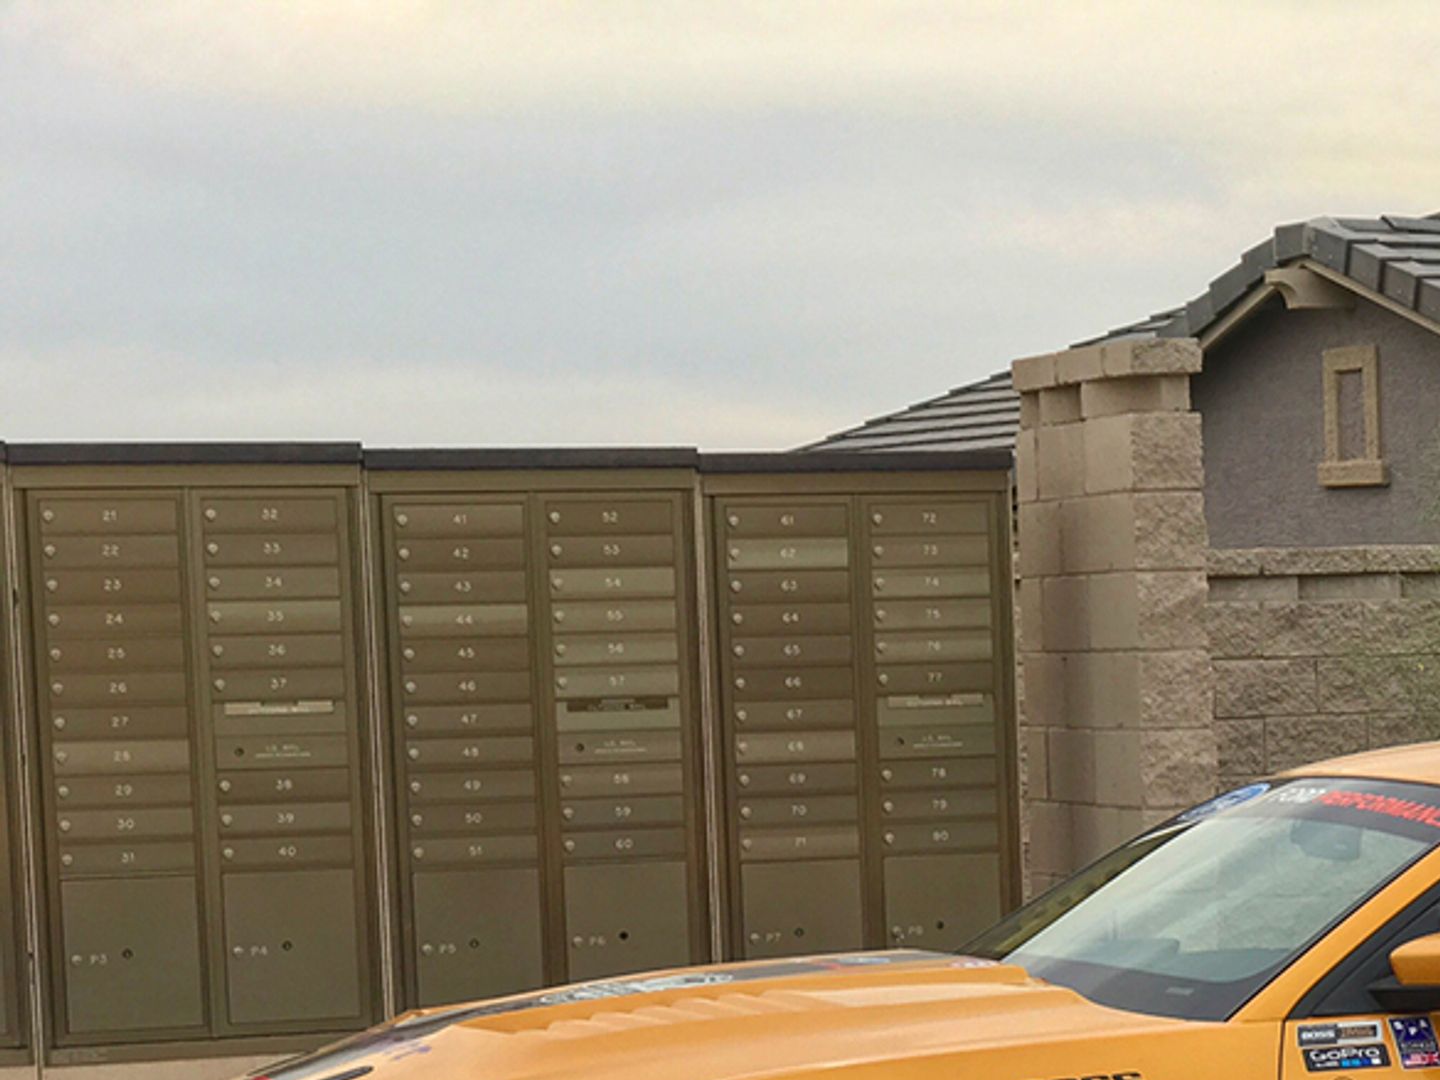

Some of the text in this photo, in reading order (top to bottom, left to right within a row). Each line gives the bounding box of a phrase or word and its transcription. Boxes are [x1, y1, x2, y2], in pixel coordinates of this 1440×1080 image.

[103, 510, 116, 521] 21
[262, 509, 277, 519] 32
[454, 514, 466, 524] 41
[603, 512, 617, 522] 52
[923, 513, 936, 523] 72
[781, 516, 793, 526] 61
[103, 545, 119, 556] 22
[264, 543, 280, 553] 33
[454, 548, 469, 558] 42
[781, 548, 795, 558] 62
[104, 580, 121, 590] 23
[266, 577, 281, 587] 34
[455, 582, 471, 592] 43
[605, 577, 620, 587] 54
[781, 581, 797, 591] 63
[106, 614, 122, 624] 24
[268, 611, 283, 621] 35
[456, 615, 472, 625] 44
[783, 613, 798, 623] 64
[108, 648, 125, 659] 25
[269, 645, 285, 655] 36
[458, 648, 474, 658] 45
[610, 676, 624, 686] 57
[928, 673, 942, 683] 77
[110, 683, 126, 693] 26
[272, 678, 286, 689] 37
[460, 682, 475, 692] 46
[462, 714, 476, 724] 47
[787, 709, 802, 719] 67
[112, 717, 128, 727] 27
[116, 785, 132, 795] 29
[465, 781, 480, 791] 49
[616, 807, 631, 817] 59
[792, 805, 806, 815] 70
[278, 813, 294, 823] 39
[465, 813, 482, 823] 50
[118, 818, 134, 829] 30
[616, 839, 633, 849] 60
[279, 846, 296, 856] 40
[470, 846, 481, 856] 51
[122, 853, 134, 863] 31
[1310, 1047, 1379, 1061] GoPro
